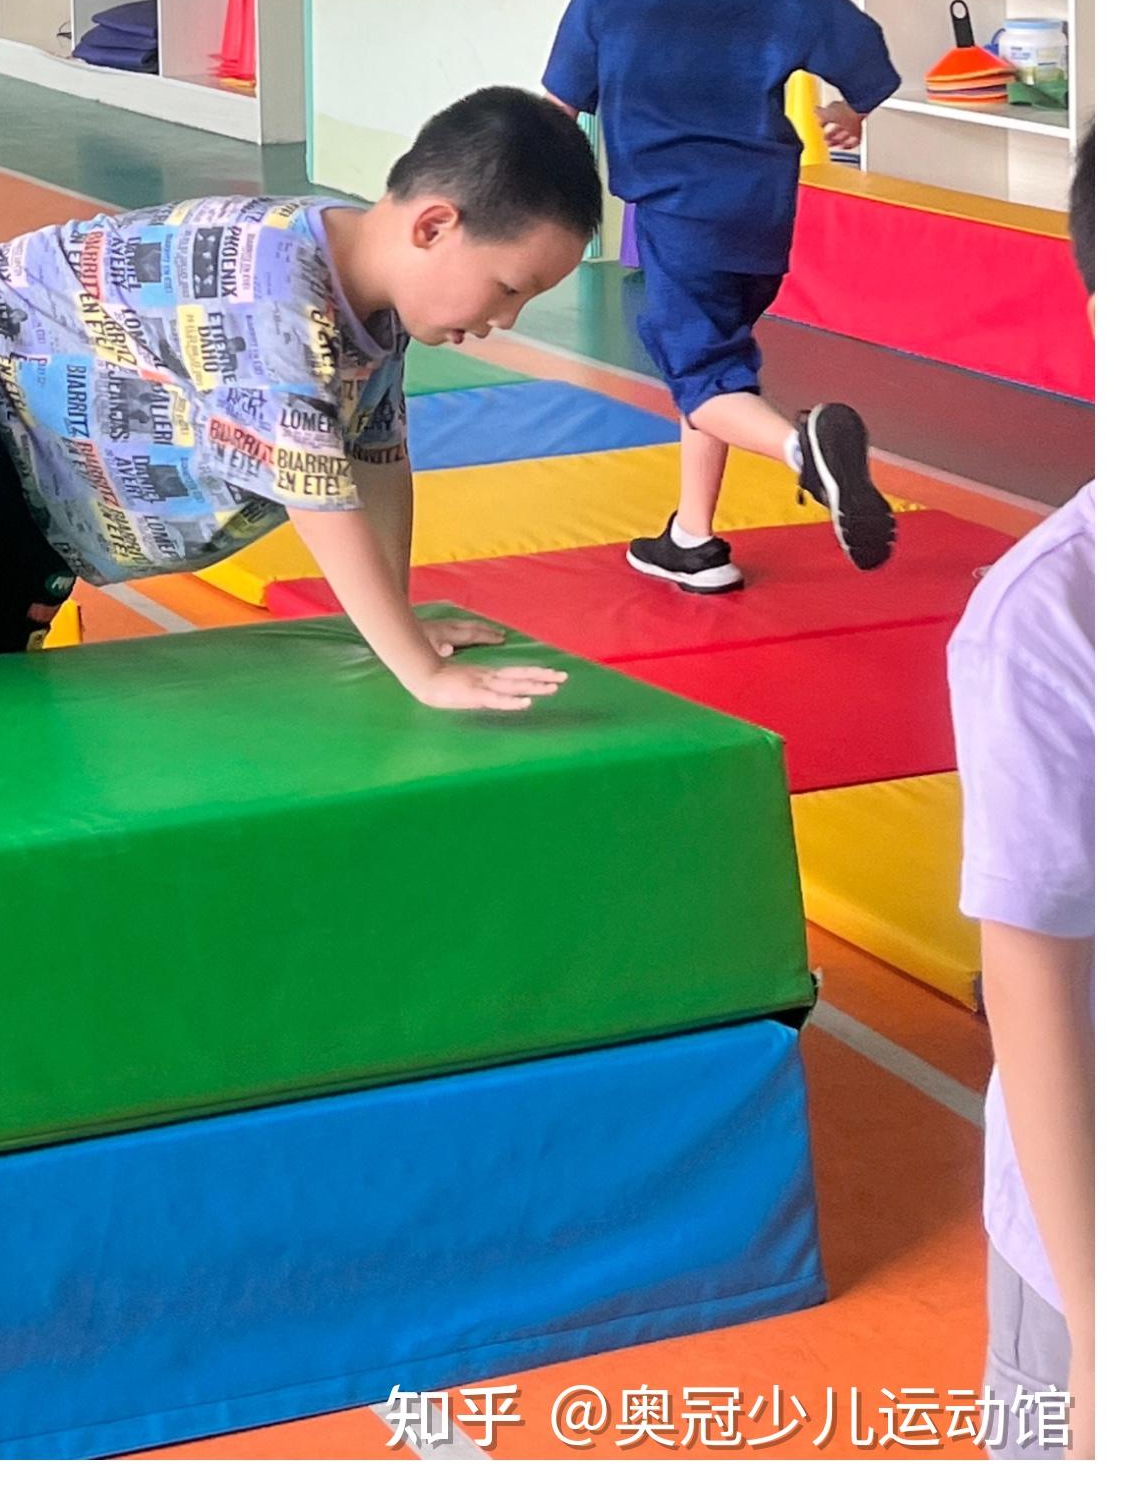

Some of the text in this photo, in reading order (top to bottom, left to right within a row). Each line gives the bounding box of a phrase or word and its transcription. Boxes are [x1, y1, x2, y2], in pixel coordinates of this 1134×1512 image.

[221, 225, 242, 297] PHOENIX
[66, 365, 91, 438] BIARRITZ
[276, 448, 353, 478] BIARRITZ
[277, 470, 296, 492] EN
